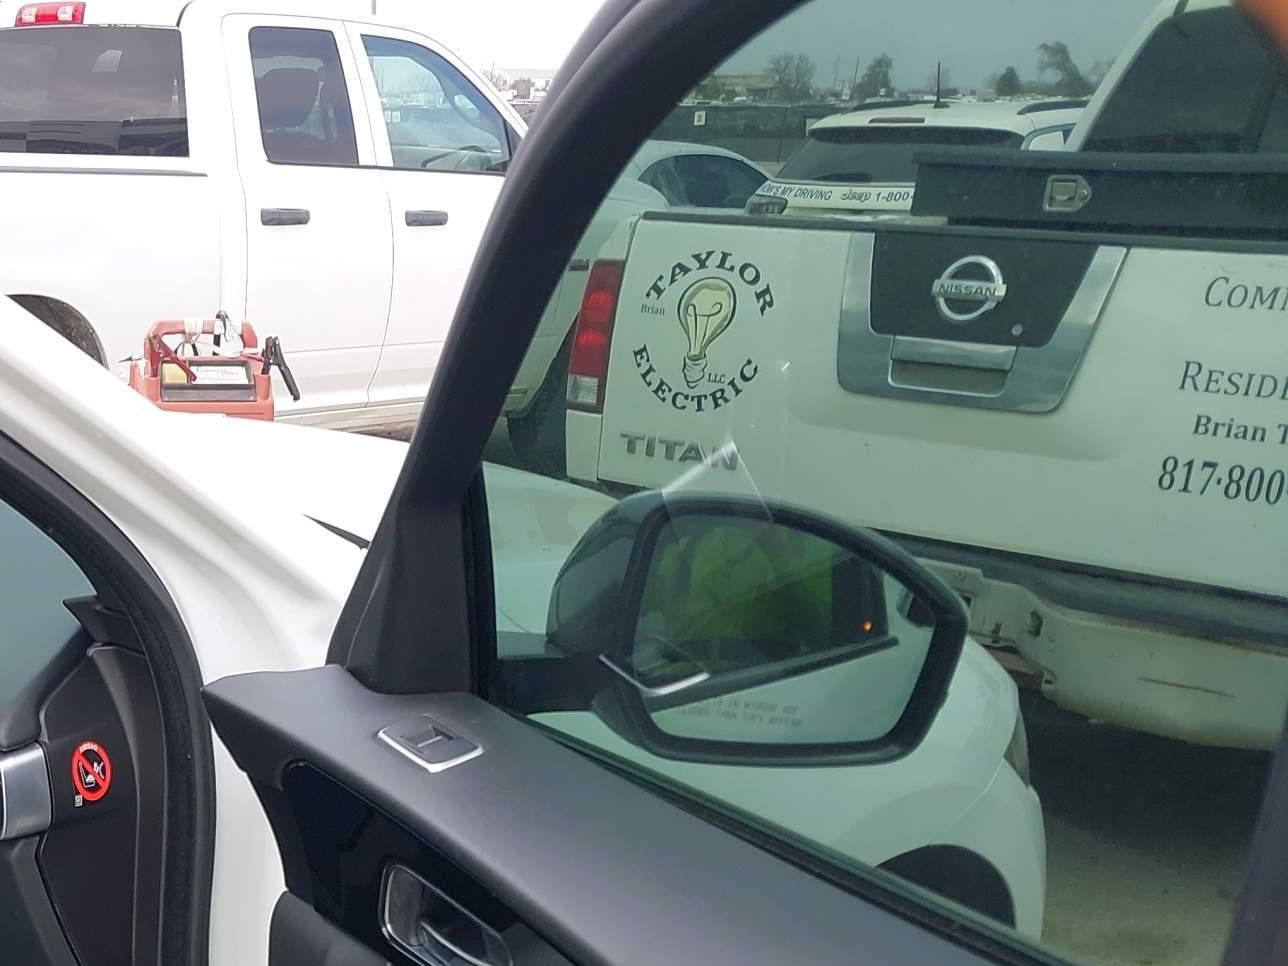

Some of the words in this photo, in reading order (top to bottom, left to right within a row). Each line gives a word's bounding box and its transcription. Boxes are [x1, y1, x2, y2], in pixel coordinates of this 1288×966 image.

[794, 187, 833, 201] DRIVING
[645, 250, 775, 317] TAYLOR
[938, 283, 996, 297] NISSAN
[1205, 276, 1288, 311] COM
[640, 303, 666, 316] Brian
[632, 344, 759, 412] ELECTRIC
[707, 372, 727, 384] LLC
[1192, 413, 1267, 443] Brian
[620, 433, 740, 471] TITAN
